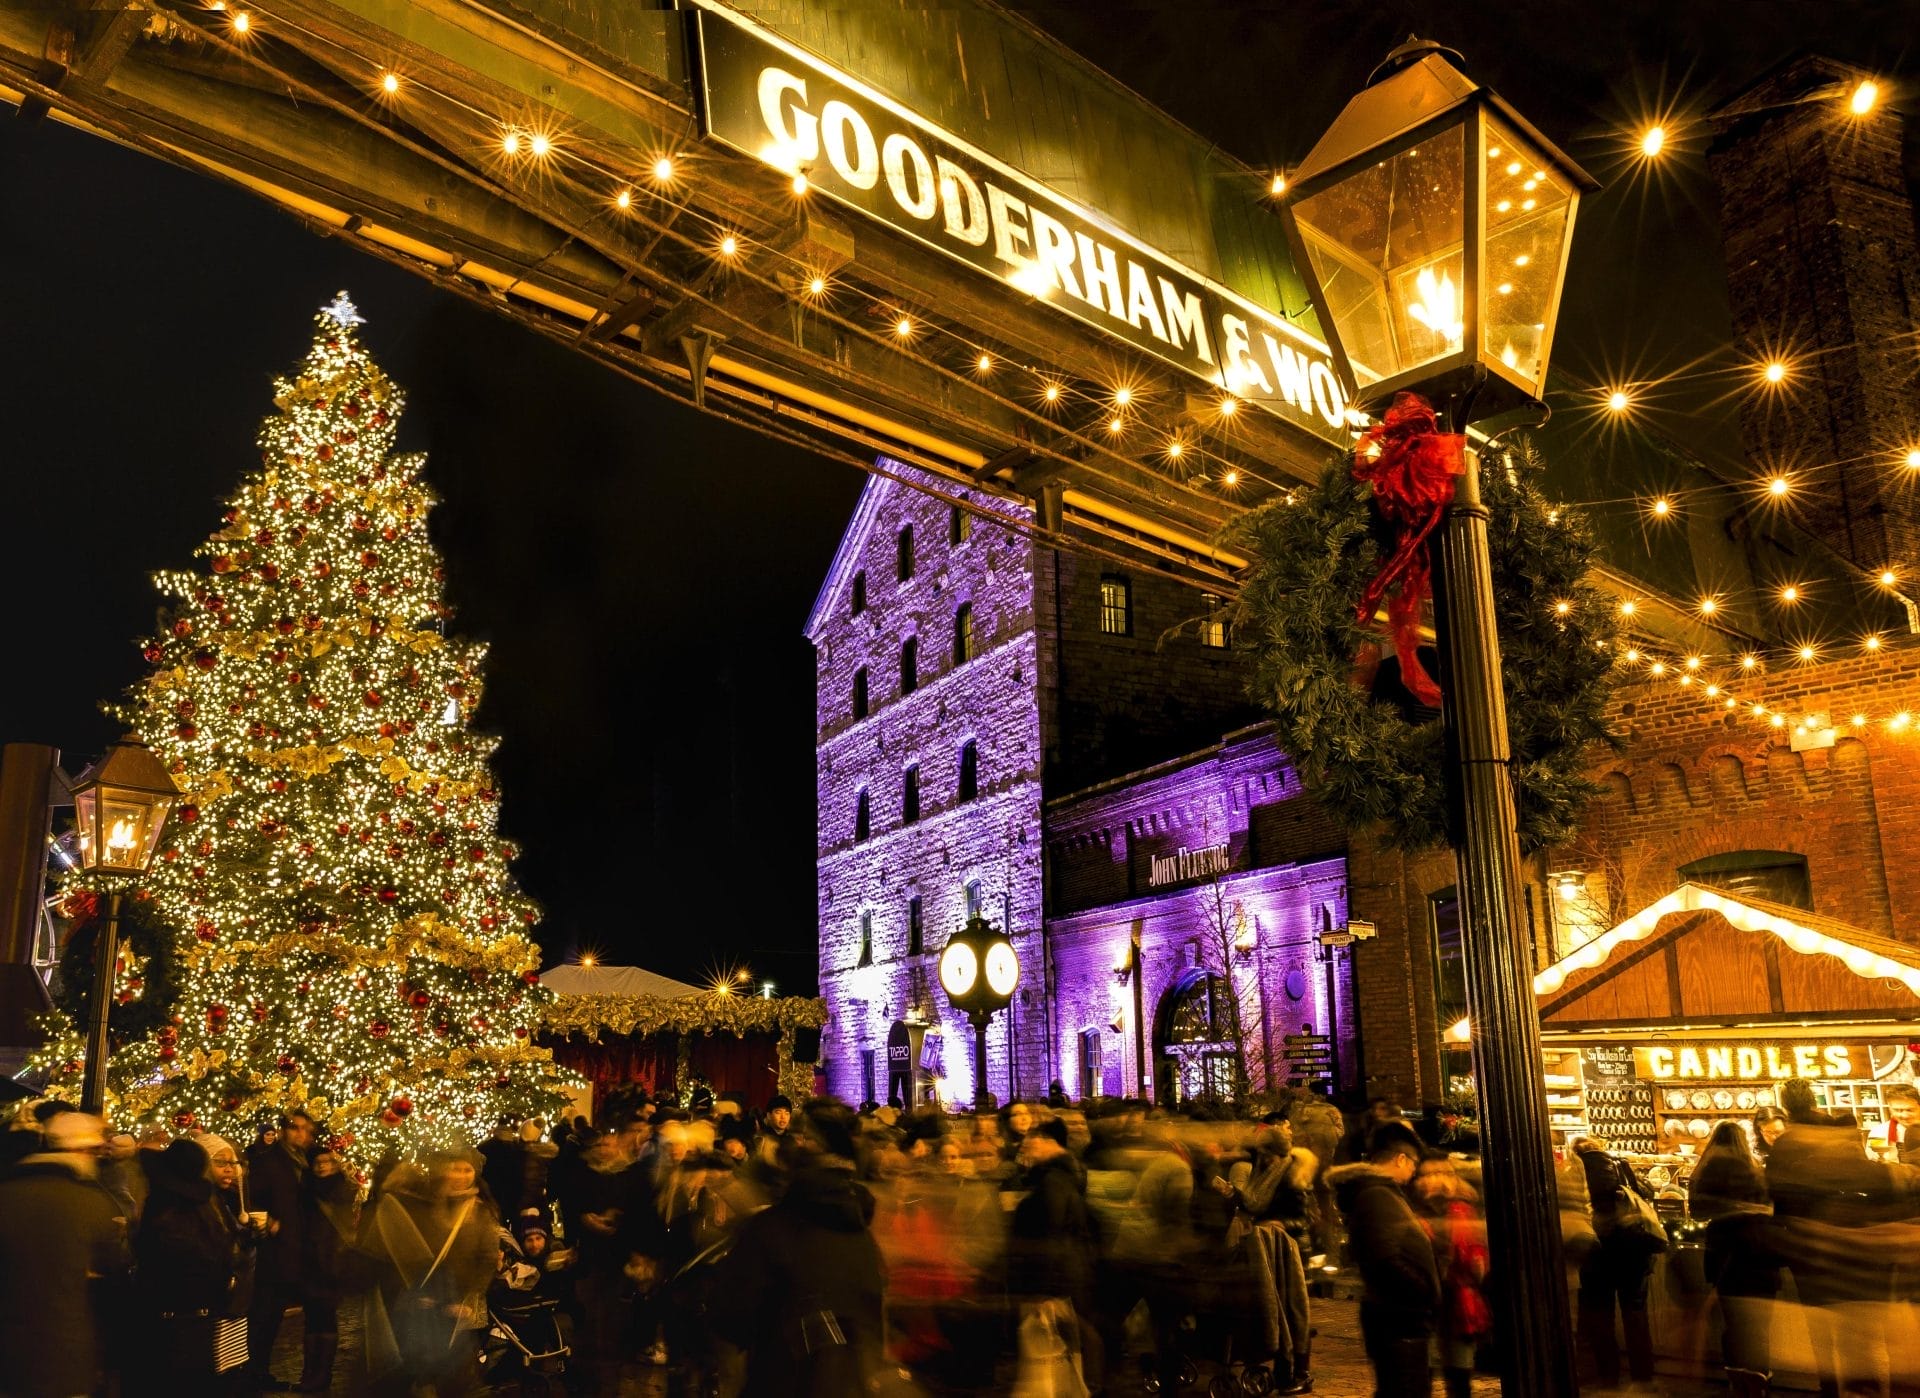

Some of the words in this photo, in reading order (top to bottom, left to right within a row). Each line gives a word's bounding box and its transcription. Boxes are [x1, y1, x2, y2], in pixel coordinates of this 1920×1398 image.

[757, 67, 1213, 366] GOODERHAM
[1222, 313, 1273, 394] &
[1262, 332, 1350, 428] WO
[1149, 854, 1177, 887] JOHN
[889, 1045, 910, 1057] TAPPO
[1650, 1045, 1852, 1079] CANDLES
